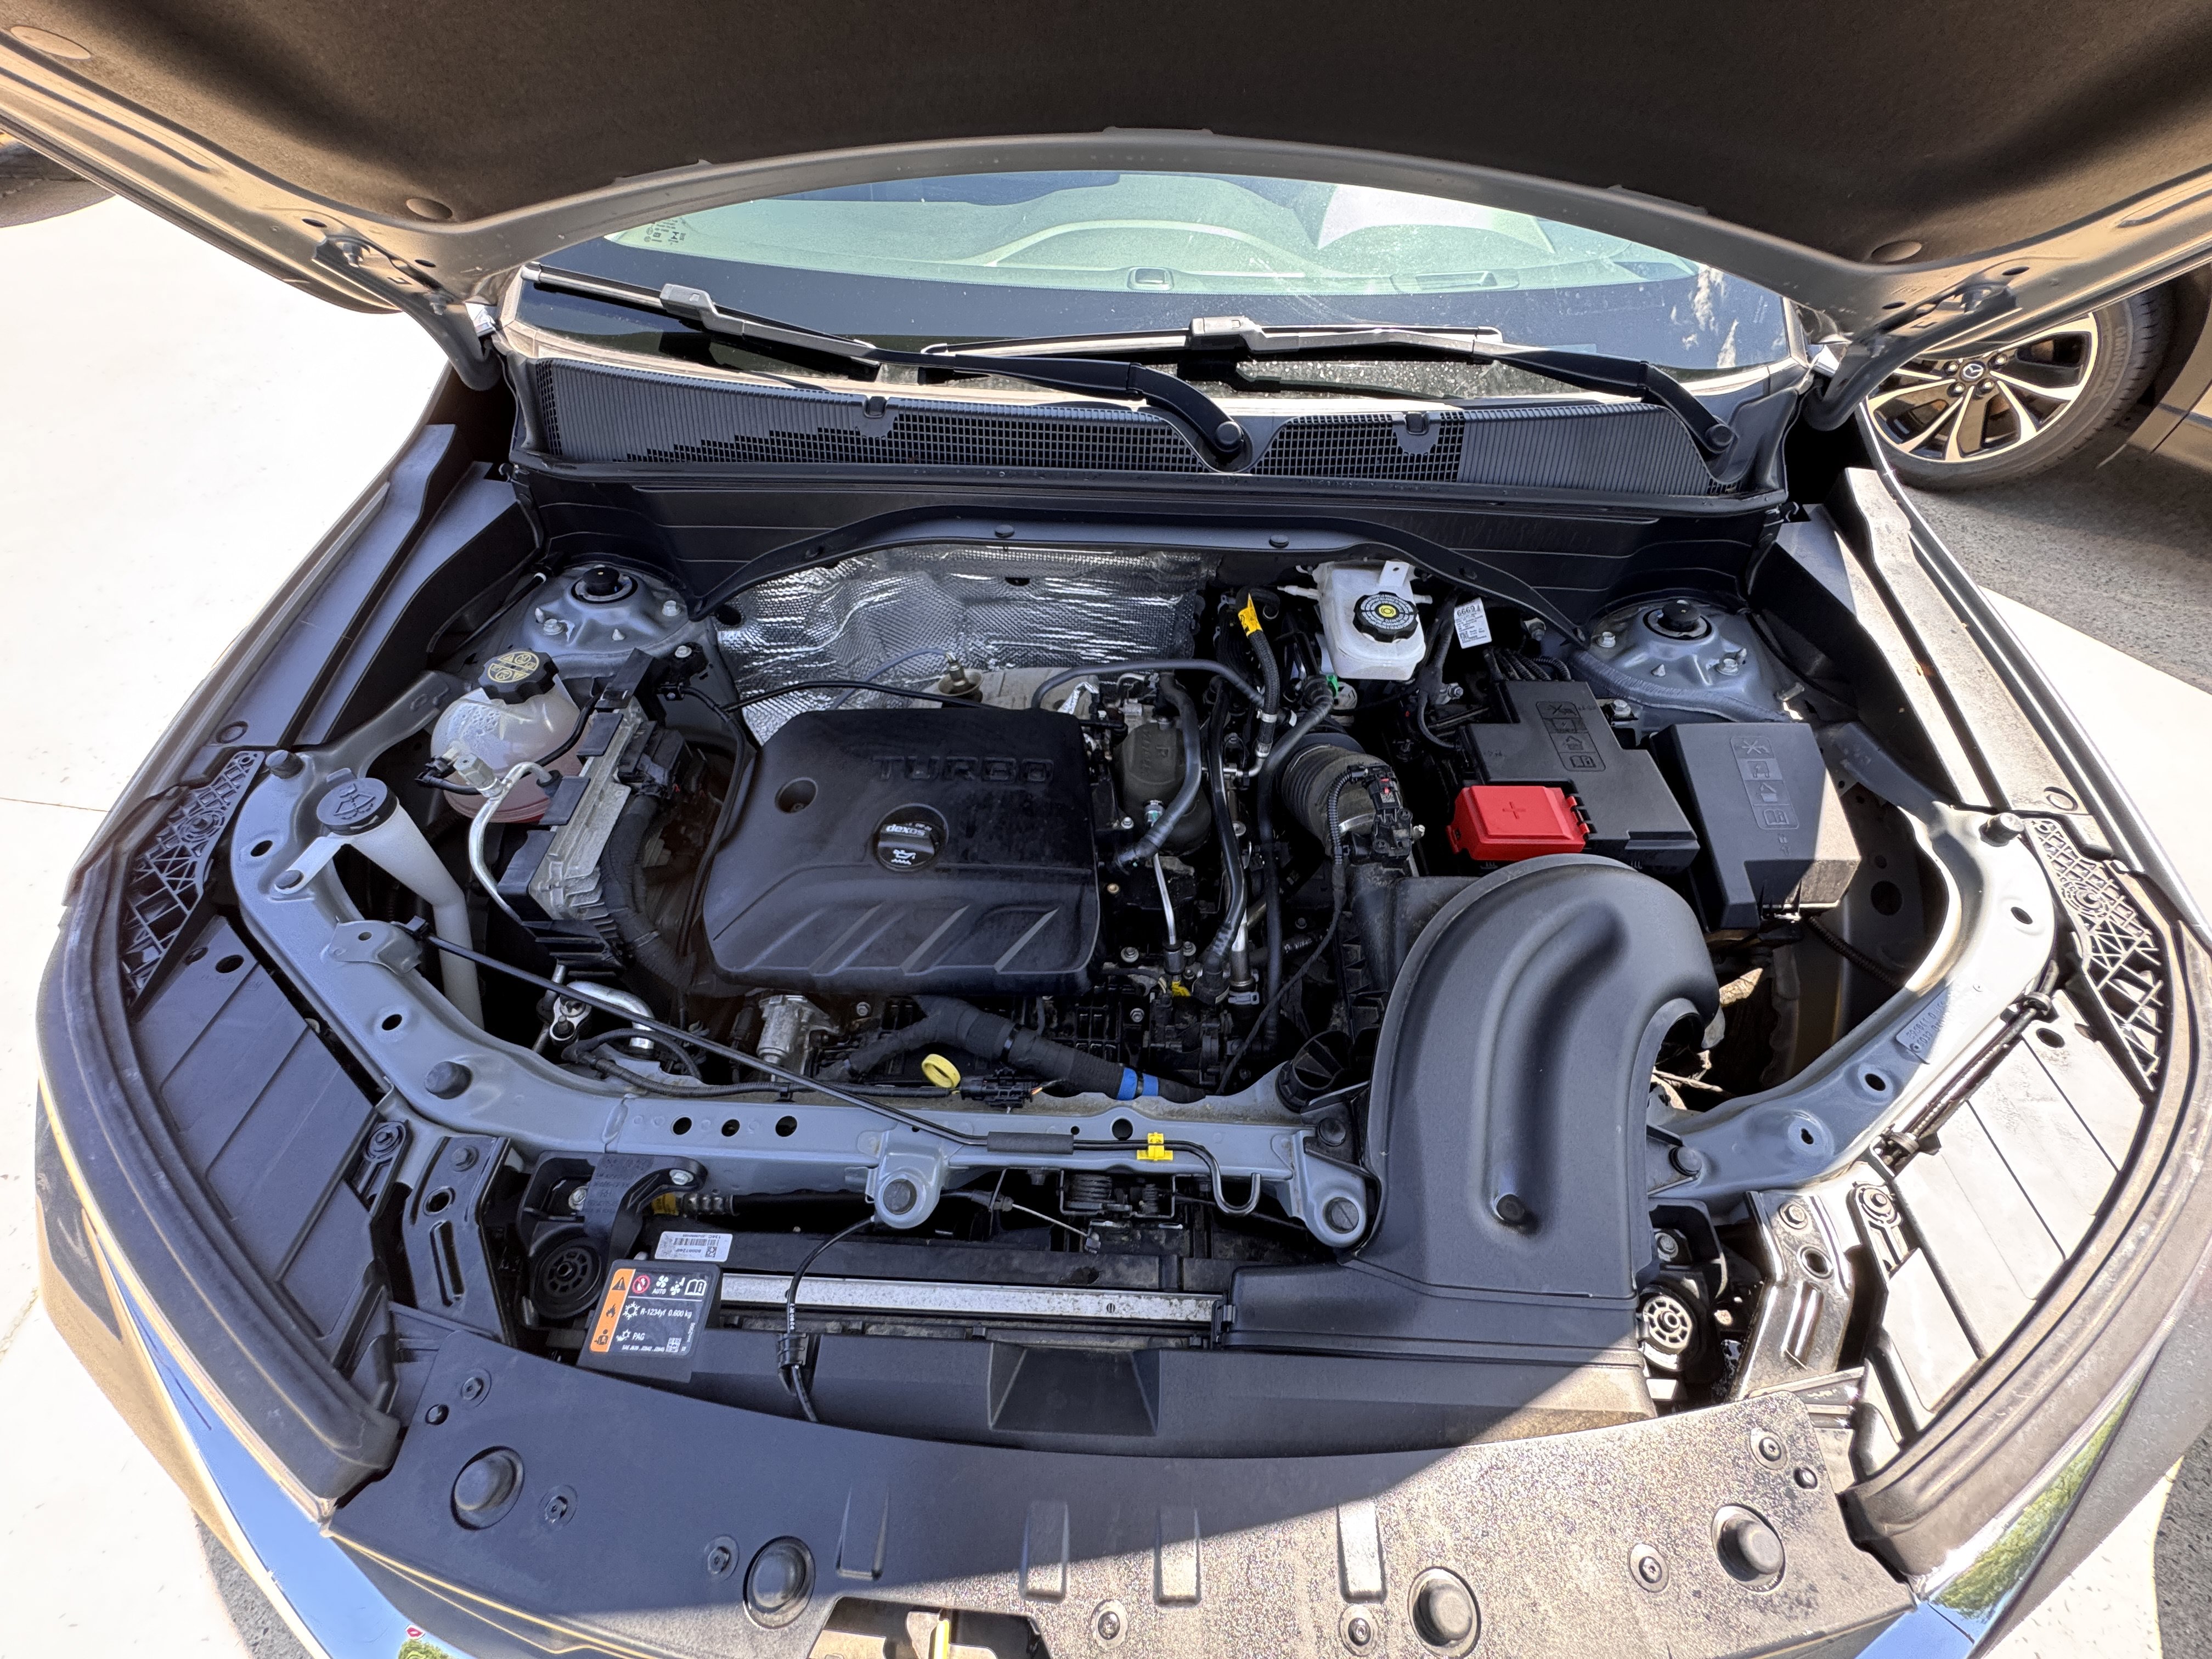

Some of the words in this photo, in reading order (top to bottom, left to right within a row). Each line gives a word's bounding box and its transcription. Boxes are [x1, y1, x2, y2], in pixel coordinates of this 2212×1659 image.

[1457, 605, 1475, 617] 6669
[872, 755, 1054, 782] TURBO
[886, 824, 926, 836] dexos
[640, 1307, 667, 1318] R-1234yf
[684, 1309, 692, 1319] kg
[631, 1332, 646, 1341] PAG
